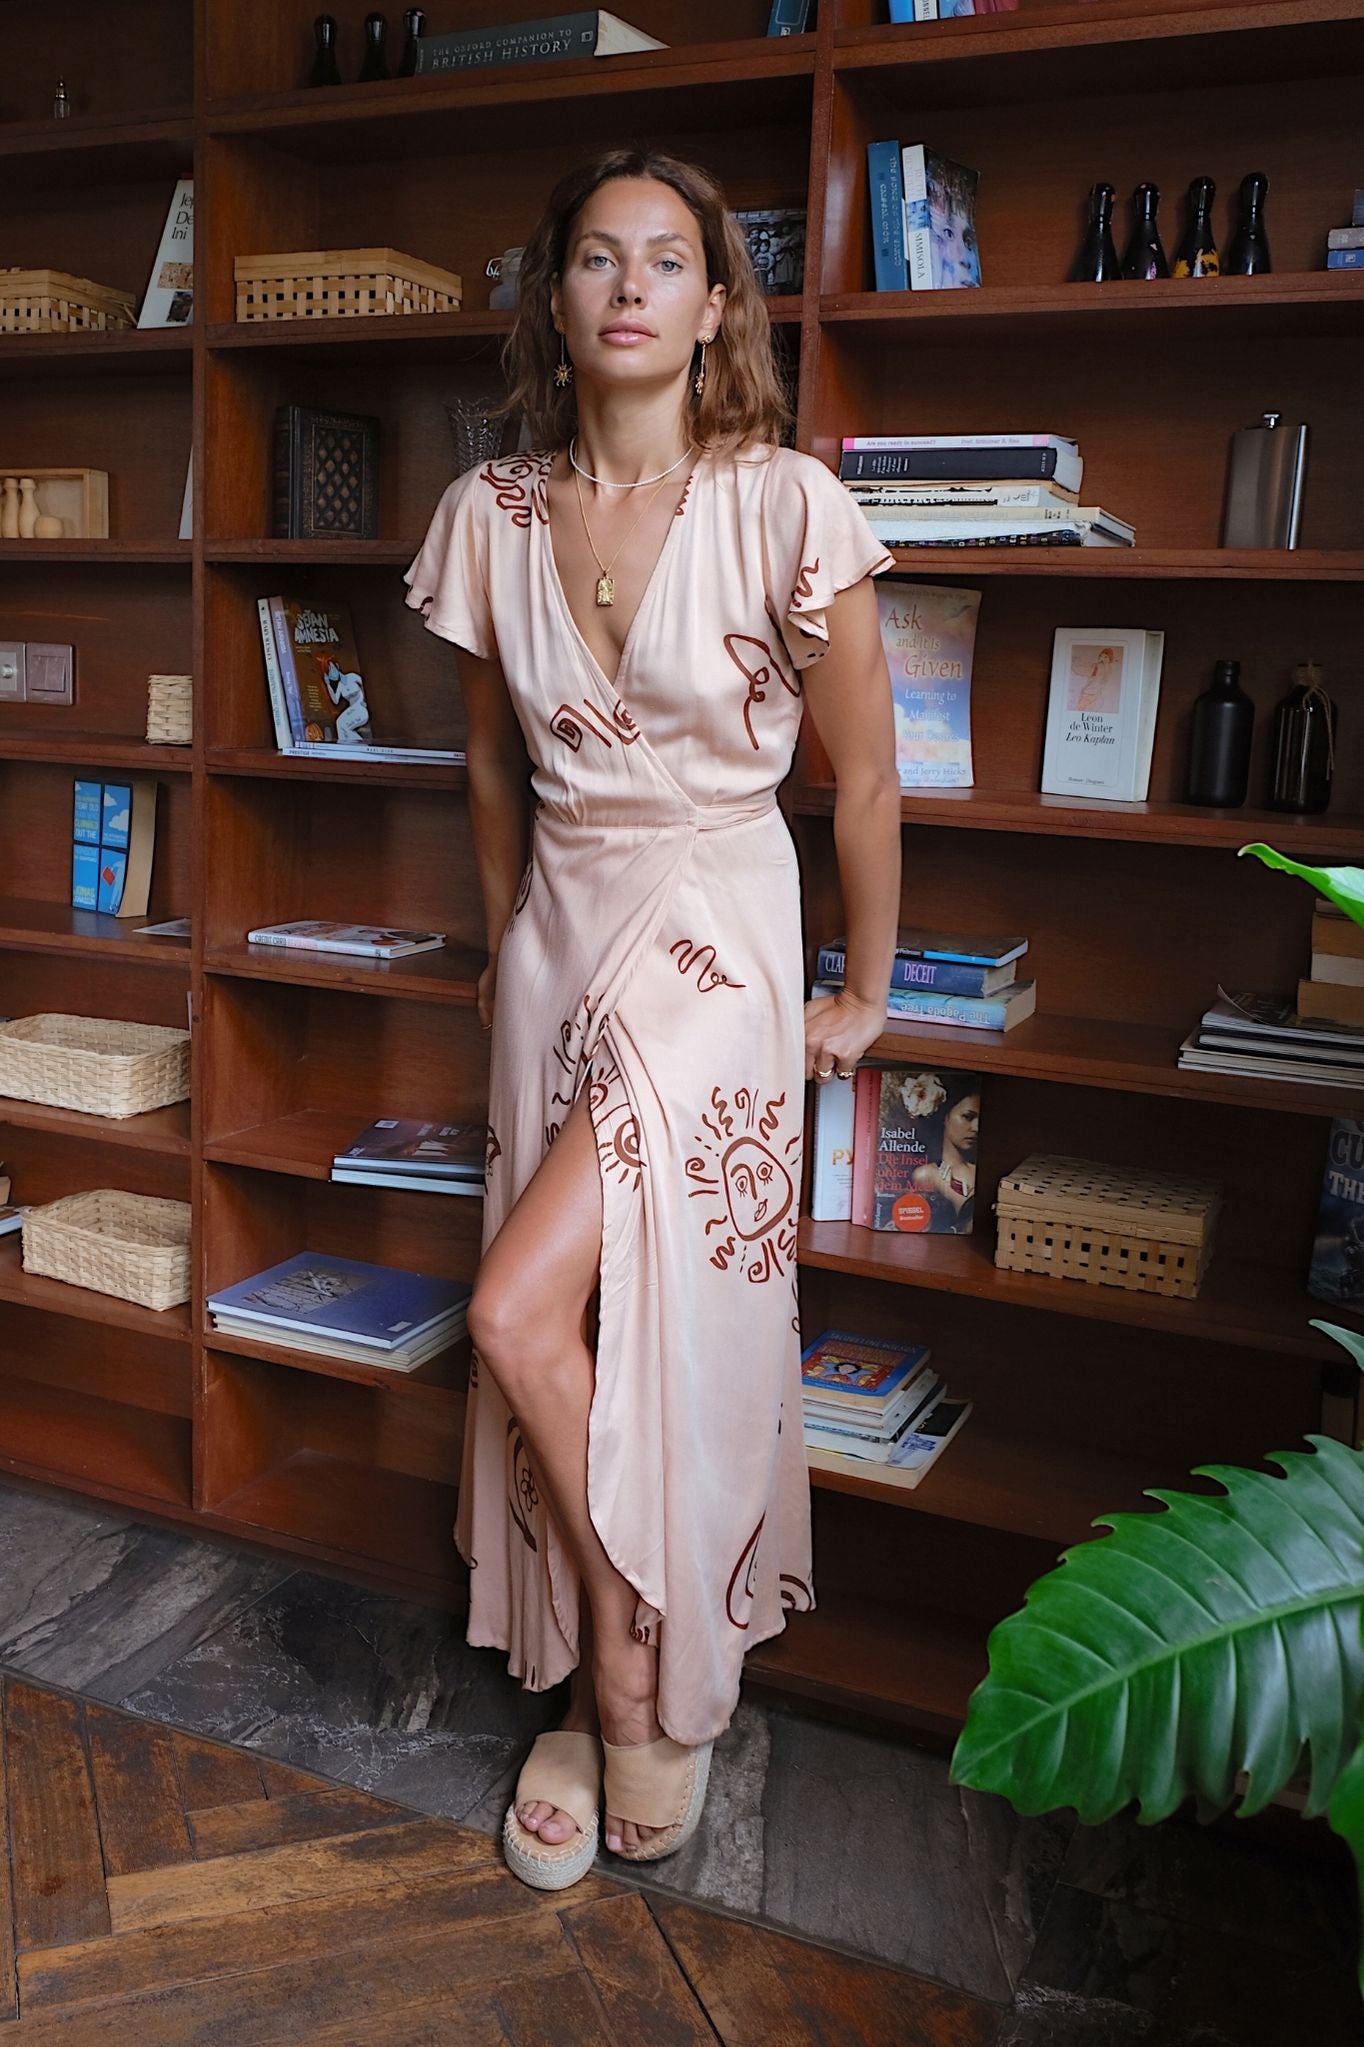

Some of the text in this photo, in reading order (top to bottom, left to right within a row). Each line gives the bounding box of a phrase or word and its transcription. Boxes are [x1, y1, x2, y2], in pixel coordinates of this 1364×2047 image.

[455, 41, 491, 53] OXFORD
[495, 31, 554, 48] COMPANION
[559, 29, 572, 37] TO
[432, 51, 494, 70] BRITISH
[502, 38, 572, 60] HISTORY
[914, 232, 925, 278] SIMISOLA
[885, 604, 922, 630] Ask
[294, 627, 339, 643] AMNESIA
[896, 633, 916, 648] and
[905, 653, 963, 678] Given
[905, 688, 957, 704] Learning to
[1081, 713, 1103, 722] Leon
[1069, 721, 1113, 733] de Winter
[1066, 732, 1115, 746] Leo Kaplan
[903, 766, 918, 775] and
[943, 767, 966, 775] Hicks
[904, 962, 937, 984] DECEIT
[901, 1002, 990, 1025] The Pagoda Tree
[880, 1127, 915, 1140] Isabel
[878, 1140, 926, 1153] Allende
[902, 1154, 928, 1165] Insel
[878, 1168, 909, 1178] unter
